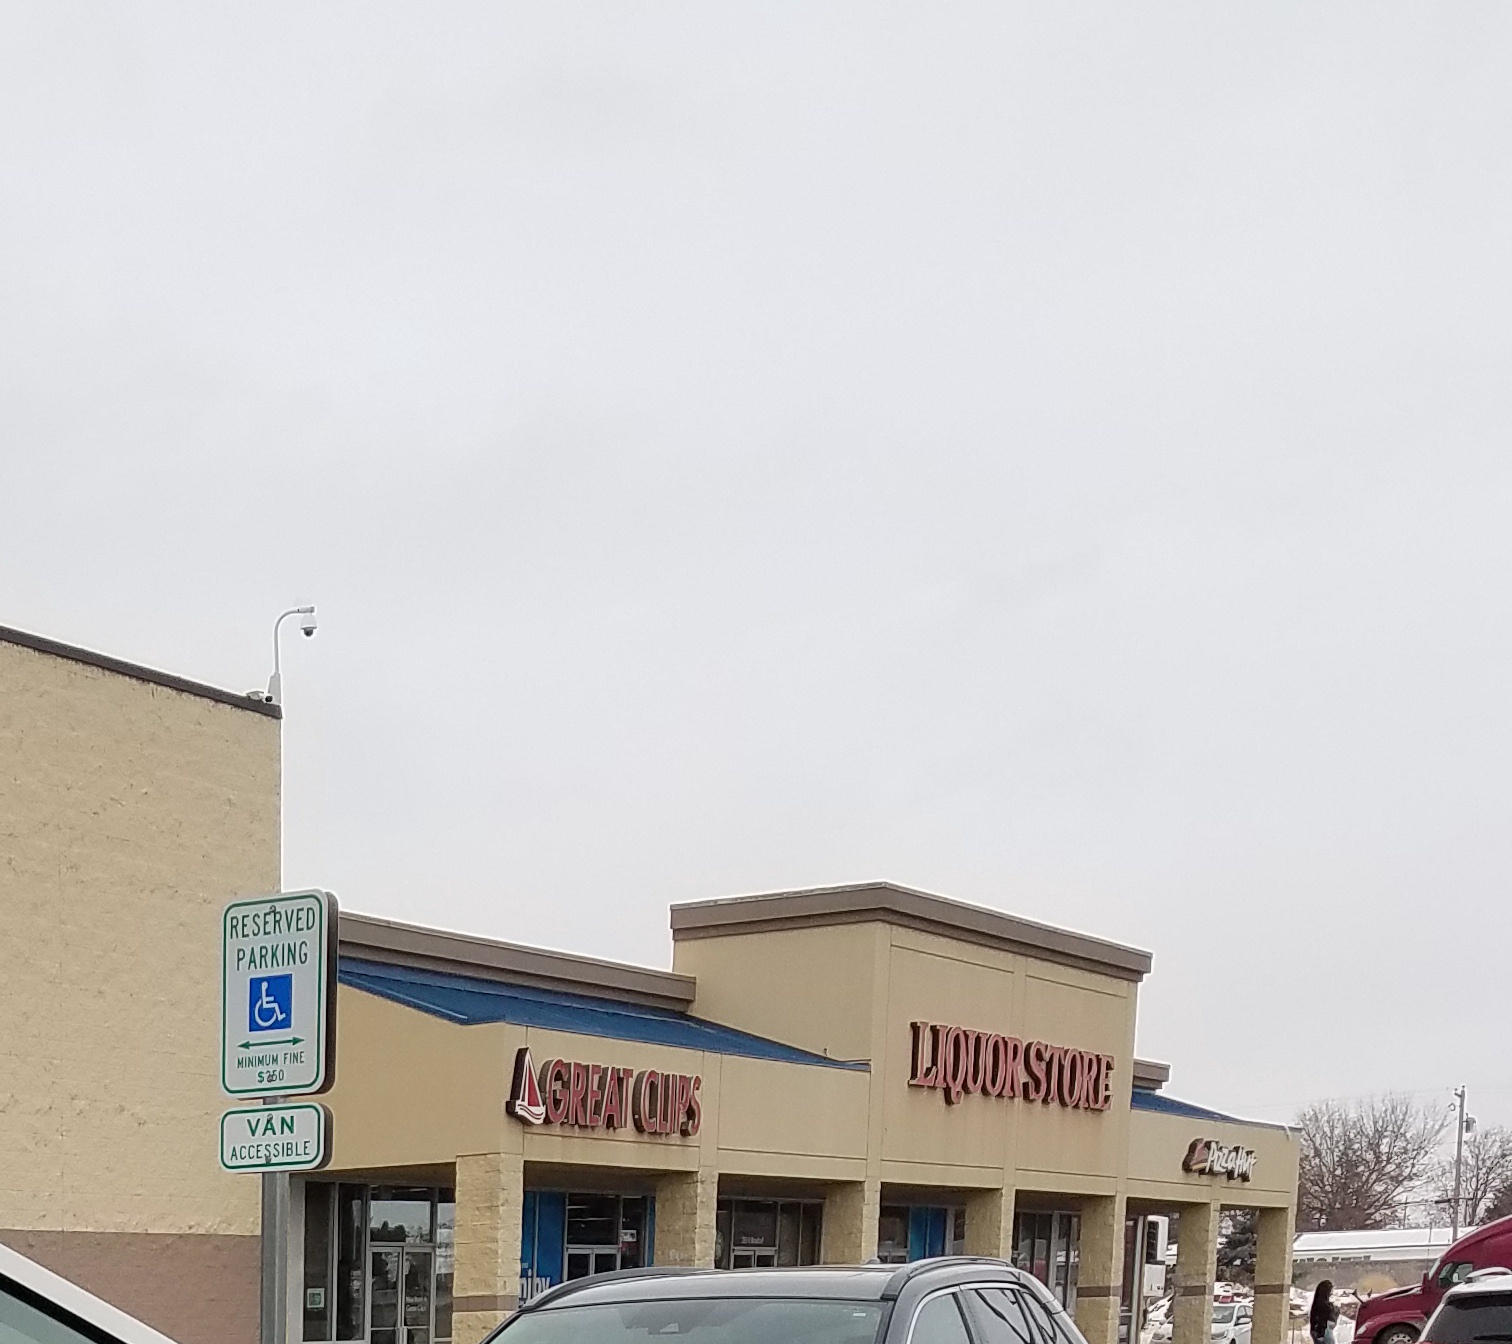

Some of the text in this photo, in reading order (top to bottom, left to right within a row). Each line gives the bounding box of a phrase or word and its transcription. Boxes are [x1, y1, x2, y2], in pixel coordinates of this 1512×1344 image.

[229, 906, 316, 940] RESERVED
[236, 940, 309, 971] PARKING
[236, 1050, 306, 1069] MINIMUM FINE
[908, 1021, 1116, 1111] LIQUOR STORE
[542, 1058, 703, 1137] GREAT CLIPS
[246, 1114, 296, 1138] VAN
[230, 1140, 311, 1162] ACCESSIBLE
